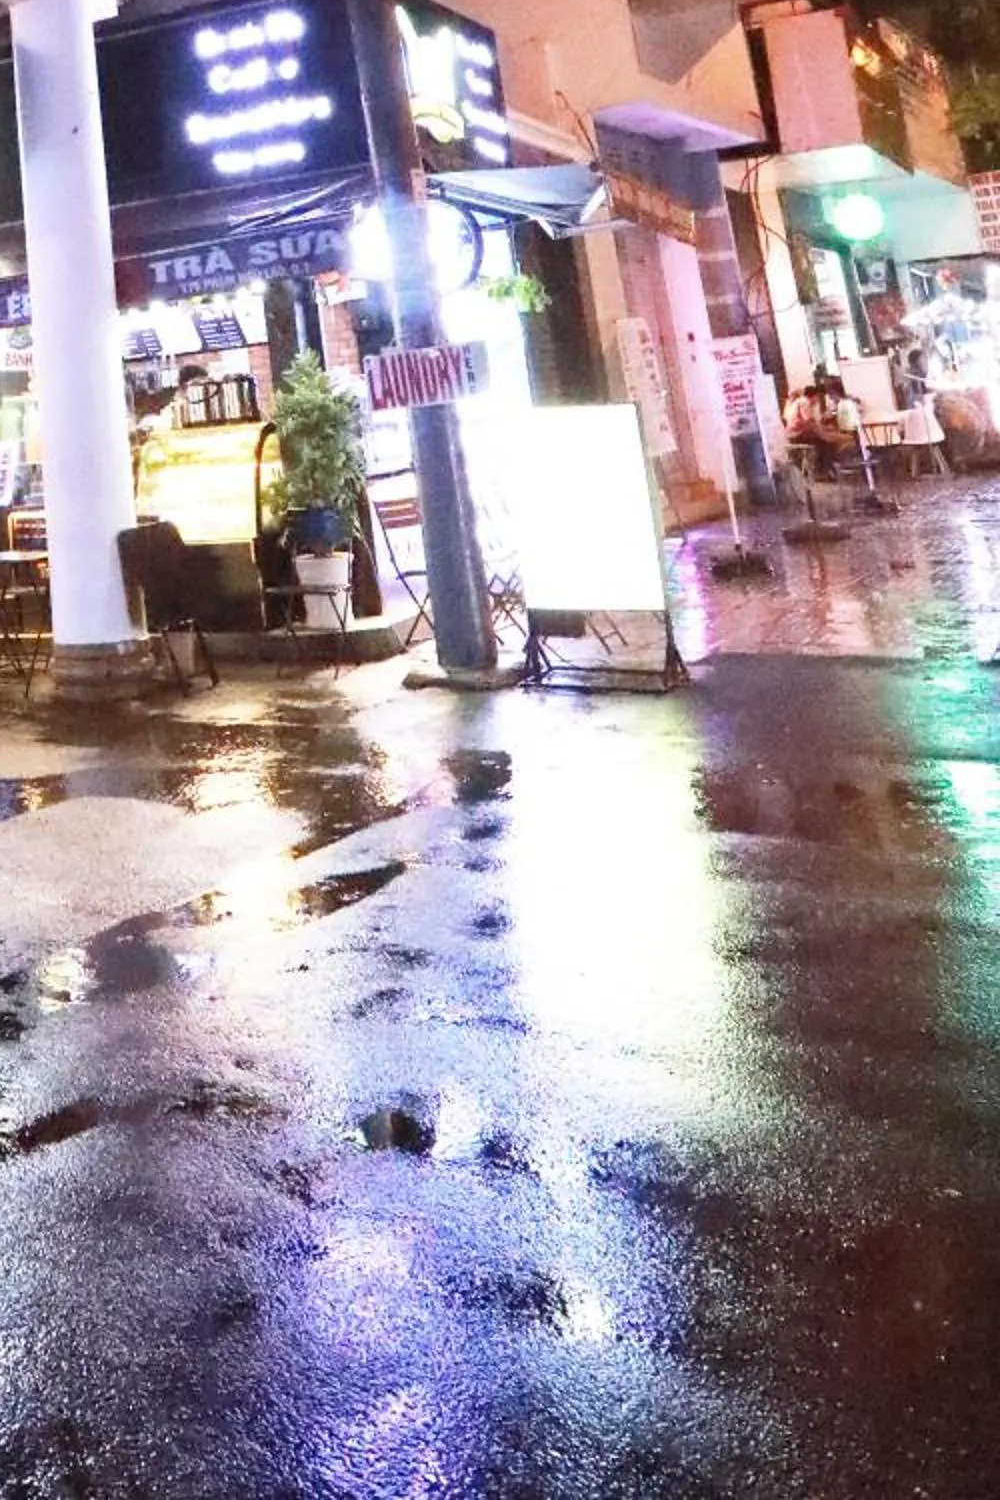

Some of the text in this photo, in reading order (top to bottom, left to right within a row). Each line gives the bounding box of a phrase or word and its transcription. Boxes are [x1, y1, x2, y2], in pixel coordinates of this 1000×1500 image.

[150, 227, 347, 284] TRÀ SỮA
[367, 347, 464, 411] LAUNDRY
